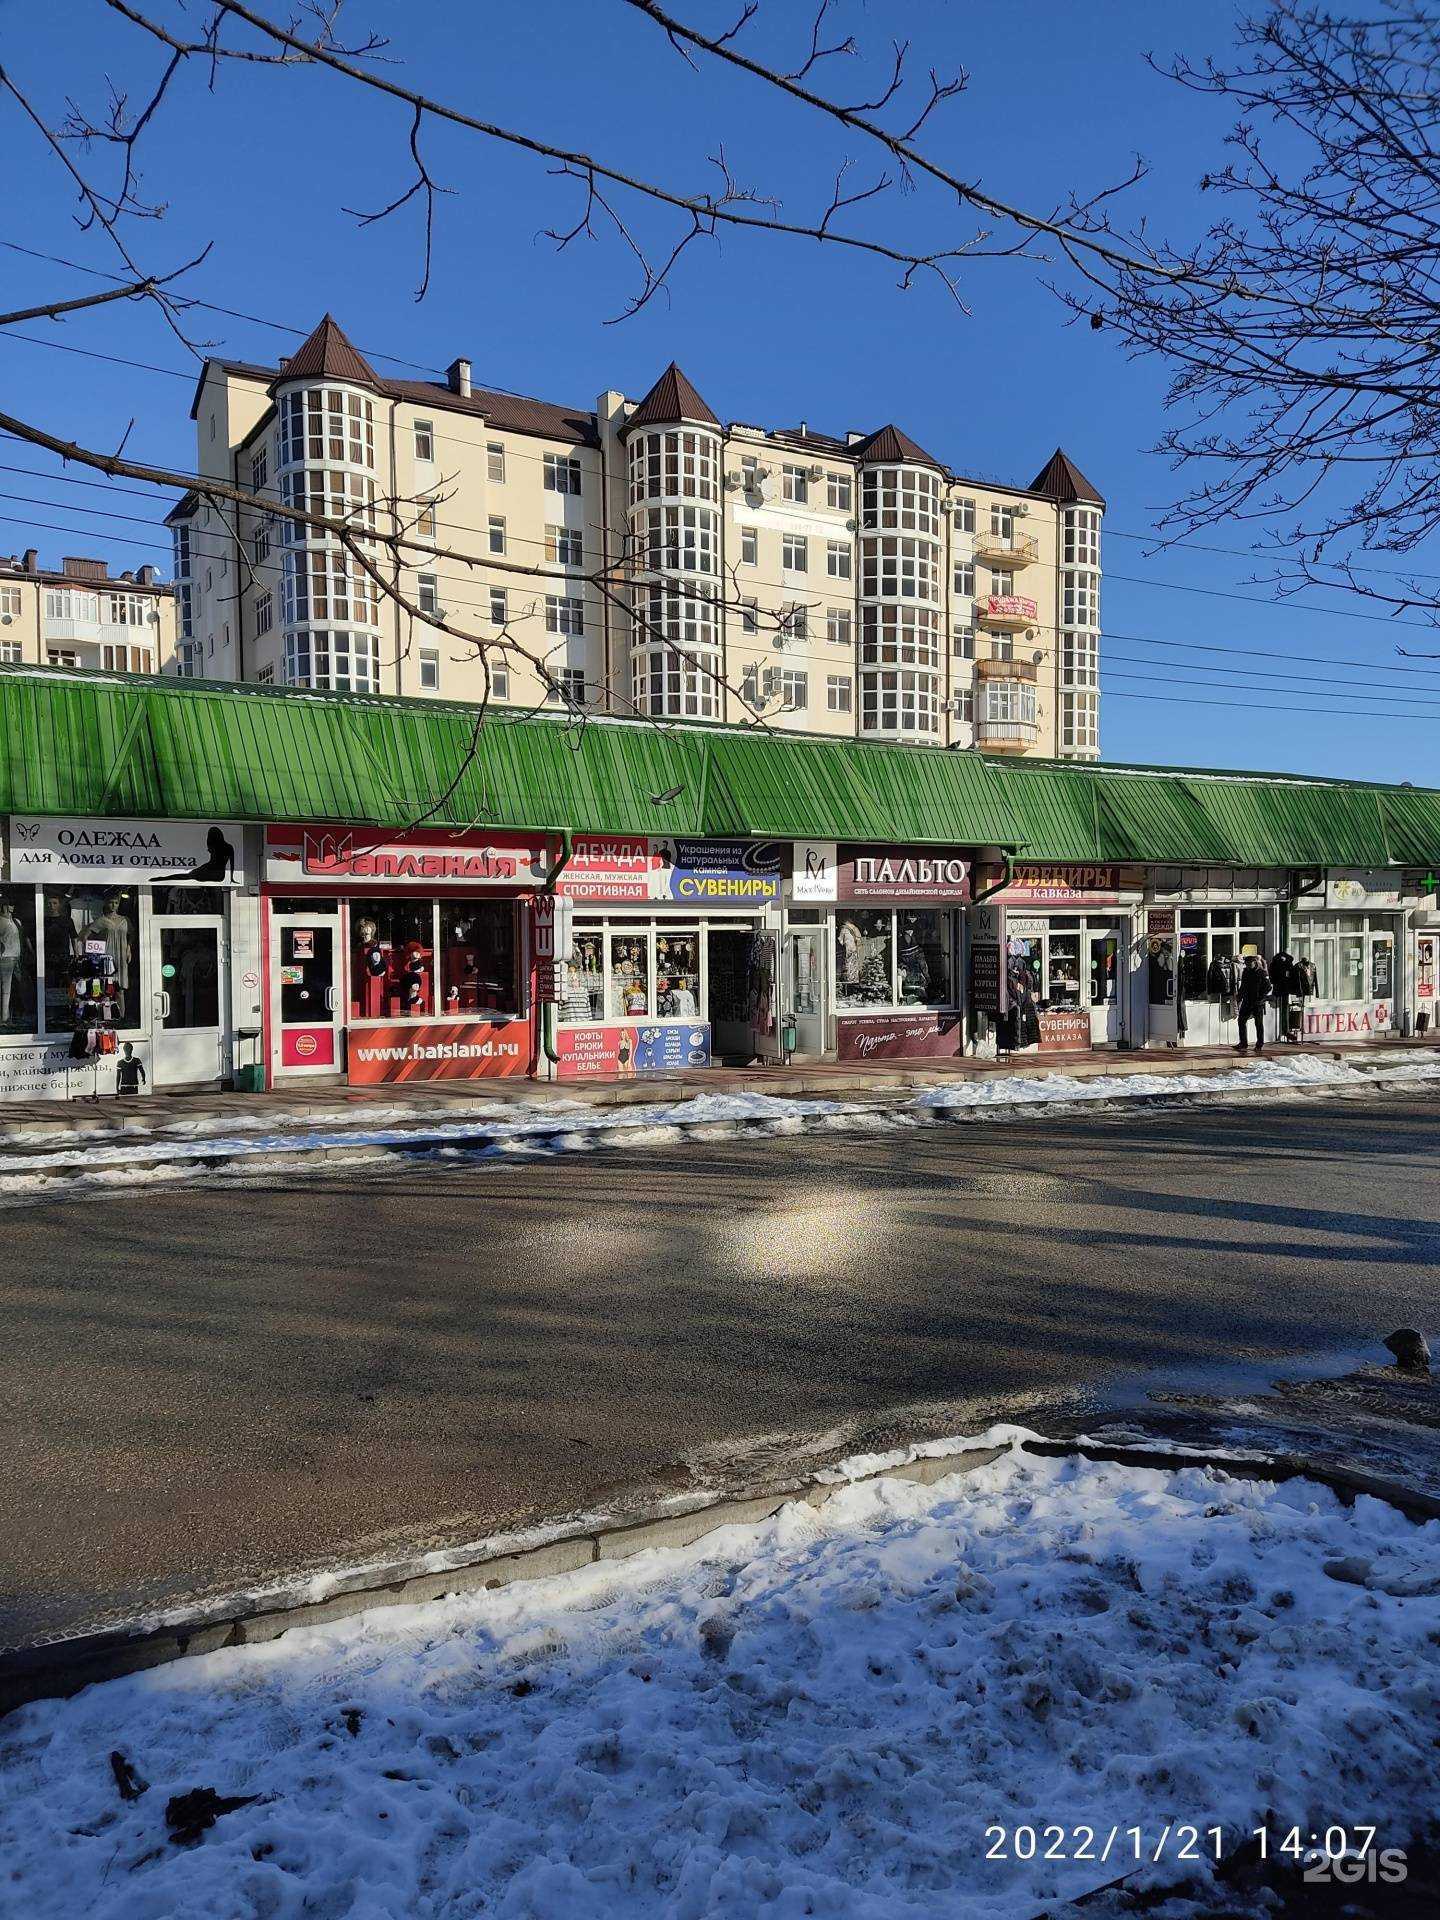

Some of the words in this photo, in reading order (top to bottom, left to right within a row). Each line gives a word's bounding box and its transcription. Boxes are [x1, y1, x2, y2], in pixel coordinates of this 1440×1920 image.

[57, 829, 163, 850] ОДЕЖДА
[560, 842, 646, 867] ДЕЖДА
[679, 844, 731, 856] Украшения
[731, 847, 742, 855] из
[19, 852, 52, 865] для
[58, 853, 105, 867] дома
[111, 855, 124, 866] и
[129, 855, 197, 867] отдыха
[681, 856, 740, 866] натуральных
[562, 872, 602, 881] ЖЕНСКАЯ,
[604, 873, 643, 881] МУЖСКАЯ
[854, 857, 968, 884] ПАЛЬТО
[1001, 866, 1112, 888] УВЕНИРЫ
[563, 884, 643, 897] СПОРТИВНАЯ
[679, 878, 777, 896] СУВЕНИРЫ
[1010, 920, 1047, 932] ОДЕЖДА
[1039, 1018, 1089, 1031] СУВЕНИРЫ
[1304, 1012, 1373, 1035] ПТЕКА
[574, 1032, 603, 1041] КОФТЫ
[1045, 1033, 1082, 1042] КАВКАЗА
[357, 1041, 519, 1062] www.hatsland.ru
[574, 1041, 603, 1050] БРЮКИ
[562, 1051, 616, 1061] КУПАЛЬНИКИ
[577, 1062, 602, 1071] БЕЛЬЕ
[0, 1083, 48, 1093] нижнее
